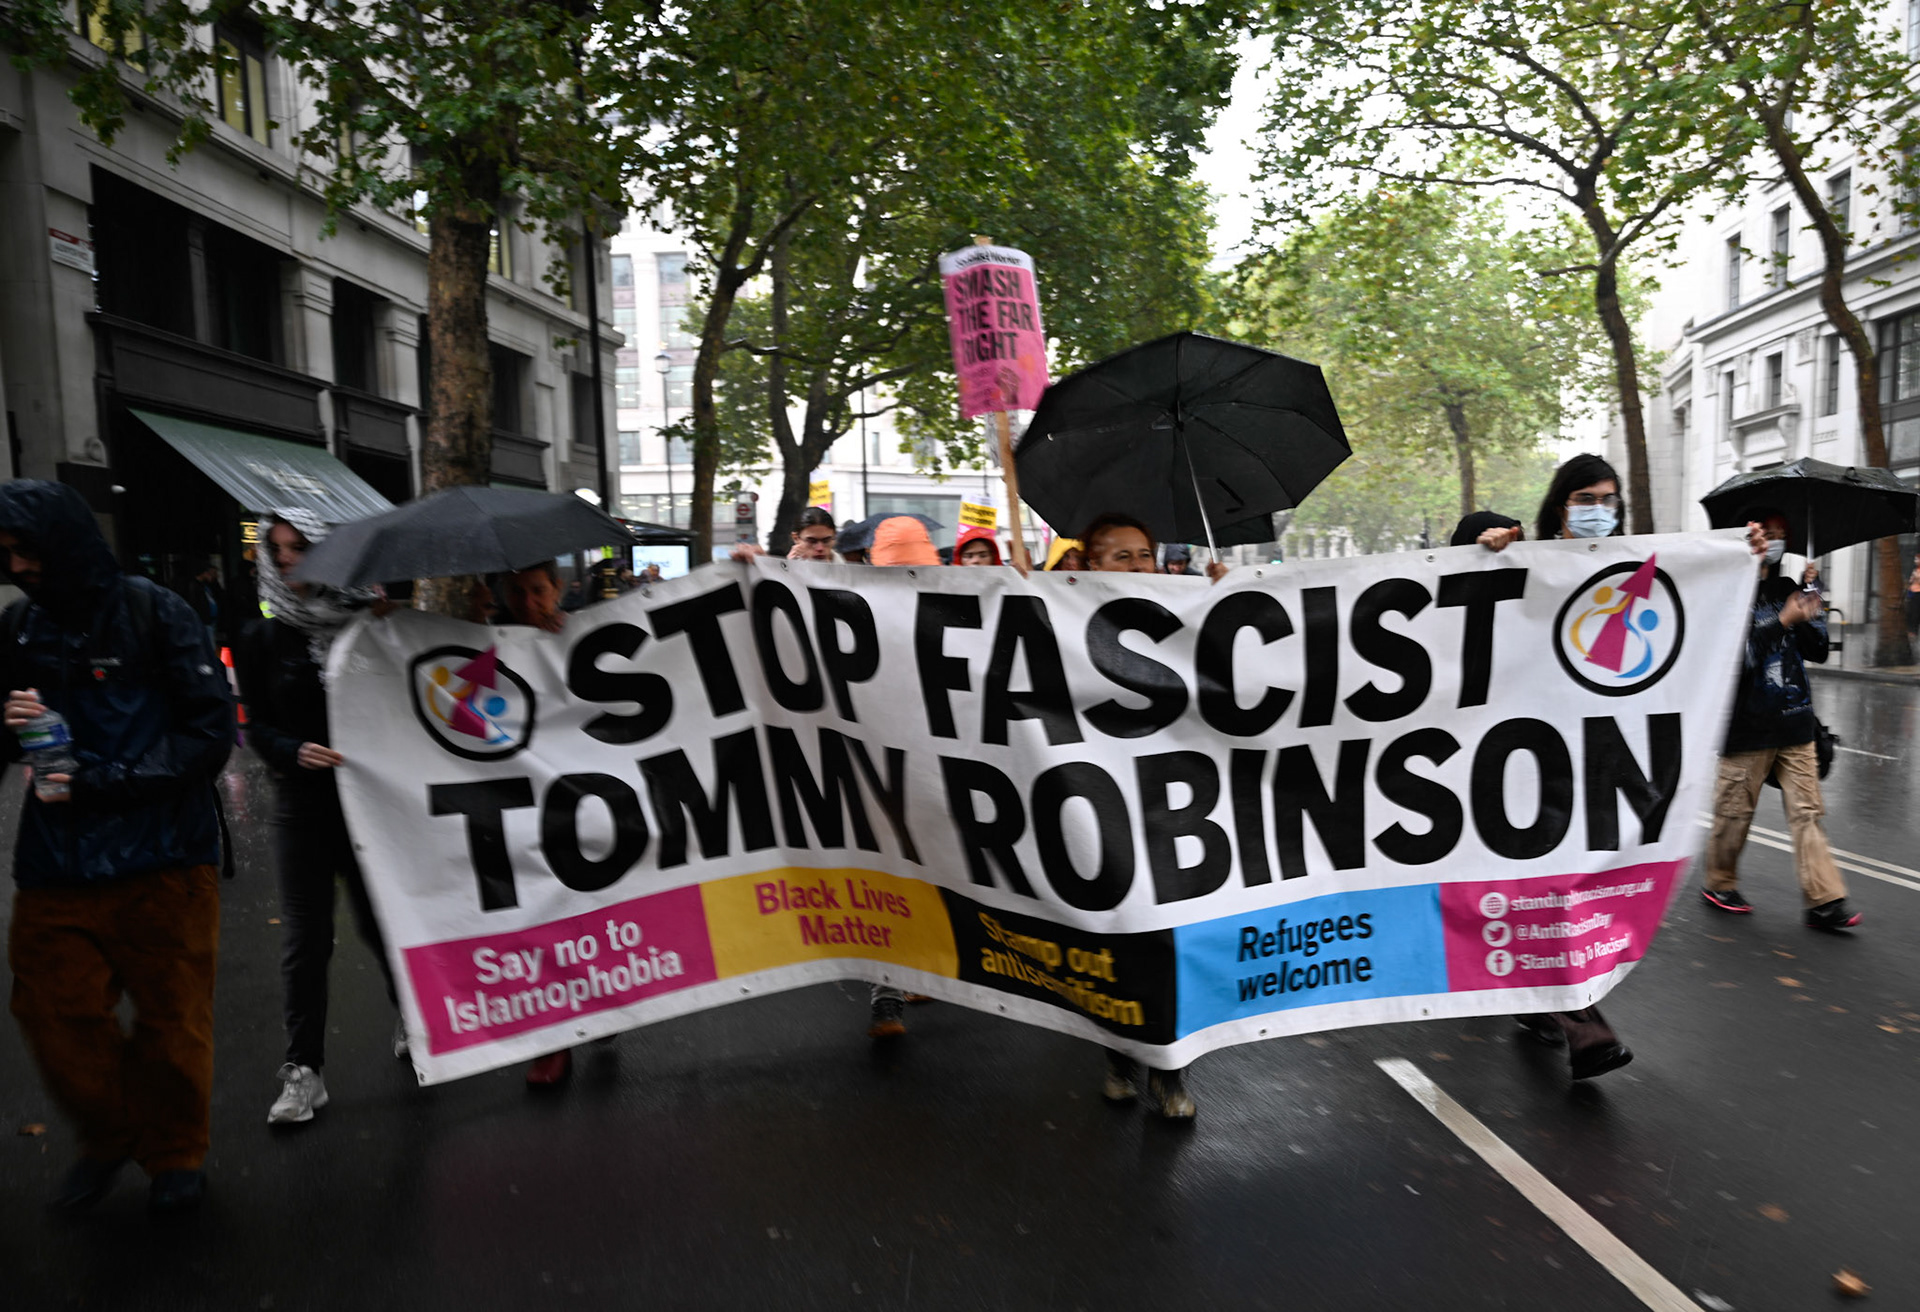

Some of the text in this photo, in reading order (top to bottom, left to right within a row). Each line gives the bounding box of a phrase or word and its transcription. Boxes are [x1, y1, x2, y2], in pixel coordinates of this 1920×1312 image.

[954, 267, 1022, 305] SMASH
[957, 301, 1035, 334] THE FAR
[962, 332, 1018, 366] RIGHT
[567, 567, 1529, 746] STOP FASCIST
[427, 712, 1682, 913] TOMMY ROBINSON
[753, 878, 913, 919] Black Lives
[797, 914, 893, 949] Matter
[978, 911, 1118, 983] Stamp out
[1237, 912, 1374, 963] Refugees
[1514, 912, 1615, 941] @AntiRacismDay
[471, 919, 643, 985] Say no to
[1568, 949, 1587, 969] Up
[1585, 944, 1595, 961] To
[443, 945, 685, 1034] Islamophobia
[1236, 955, 1374, 1002] welcome
